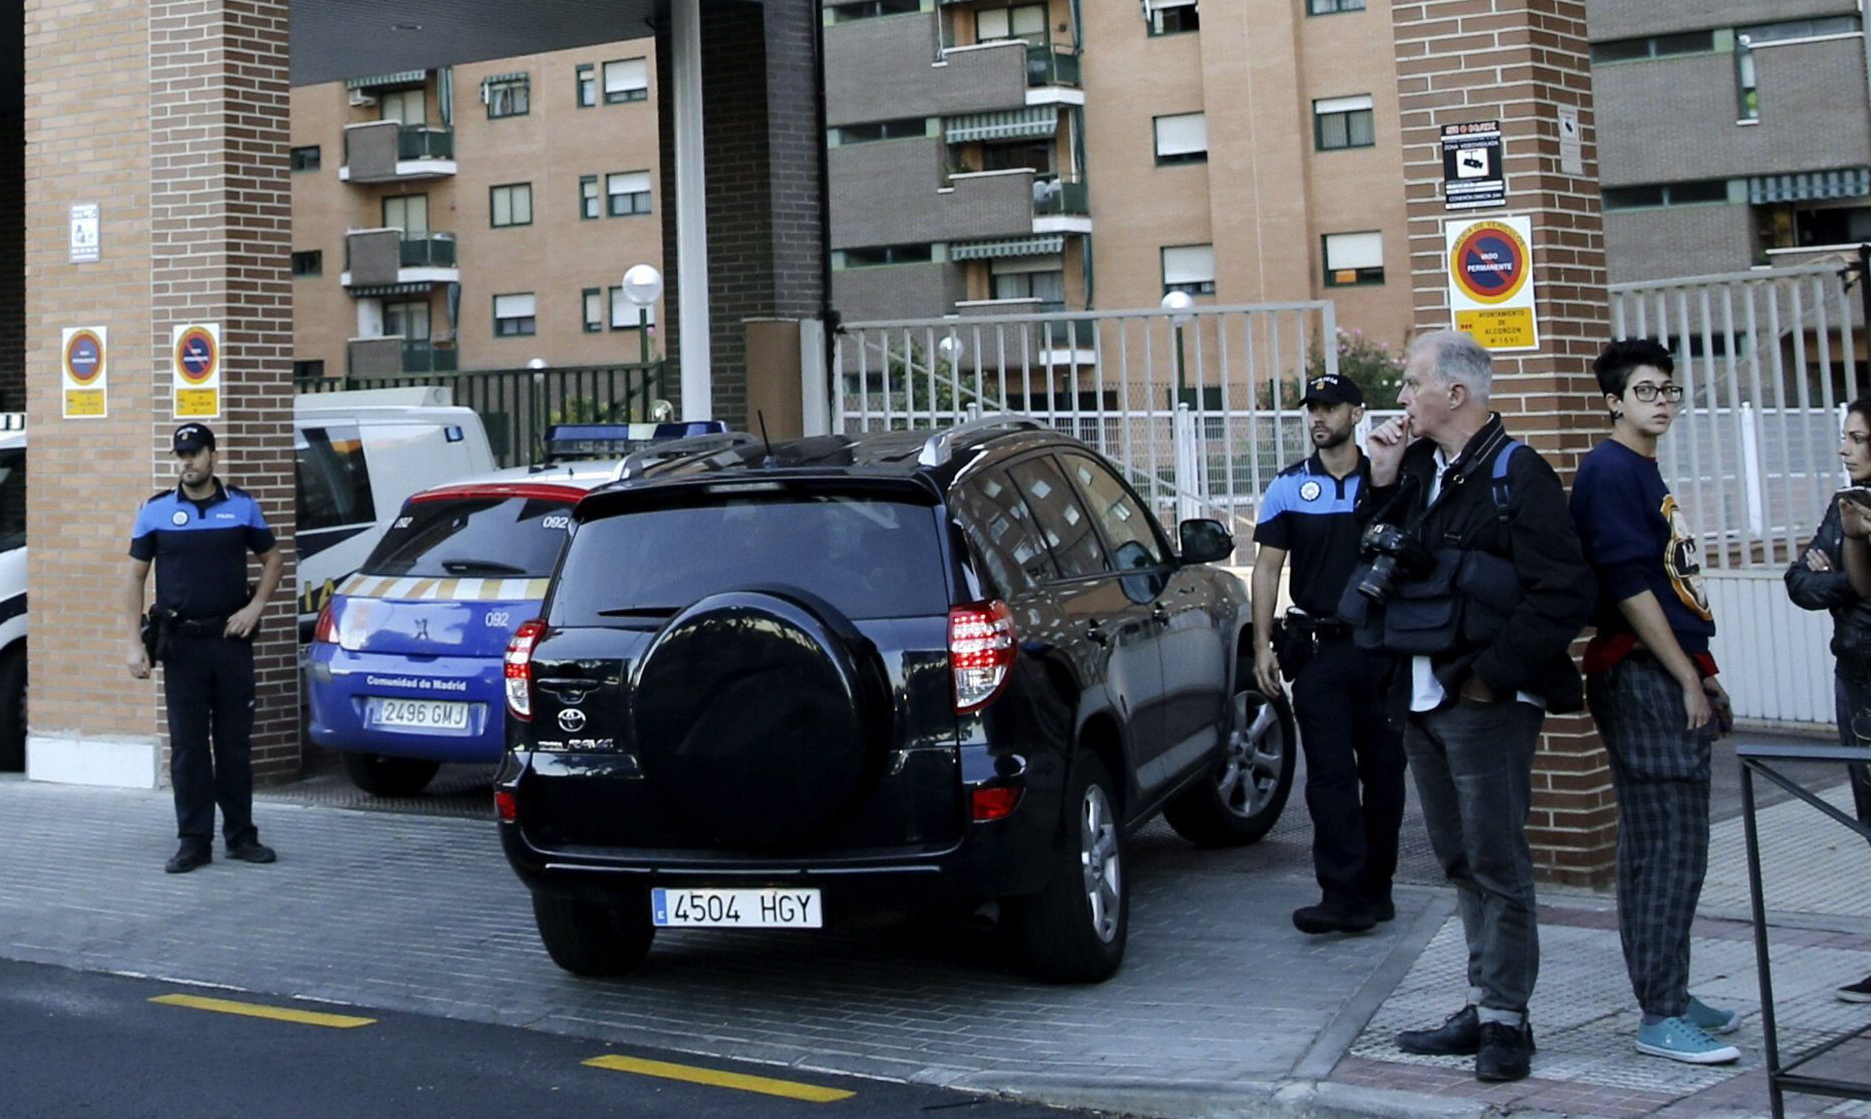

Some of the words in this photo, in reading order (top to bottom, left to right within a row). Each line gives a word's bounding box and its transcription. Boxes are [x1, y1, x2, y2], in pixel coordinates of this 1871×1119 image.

[1480, 252, 1499, 260] VADO
[1467, 262, 1513, 272] PERMANENTE
[542, 515, 568, 529] 092
[485, 612, 509, 627] 092
[366, 675, 418, 688] Comunidad
[419, 678, 431, 689] de
[433, 680, 466, 691] Madrid
[384, 701, 427, 722] 2496
[431, 704, 465, 725] GMJ
[674, 894, 741, 923] 4504
[760, 894, 811, 923] HGY
